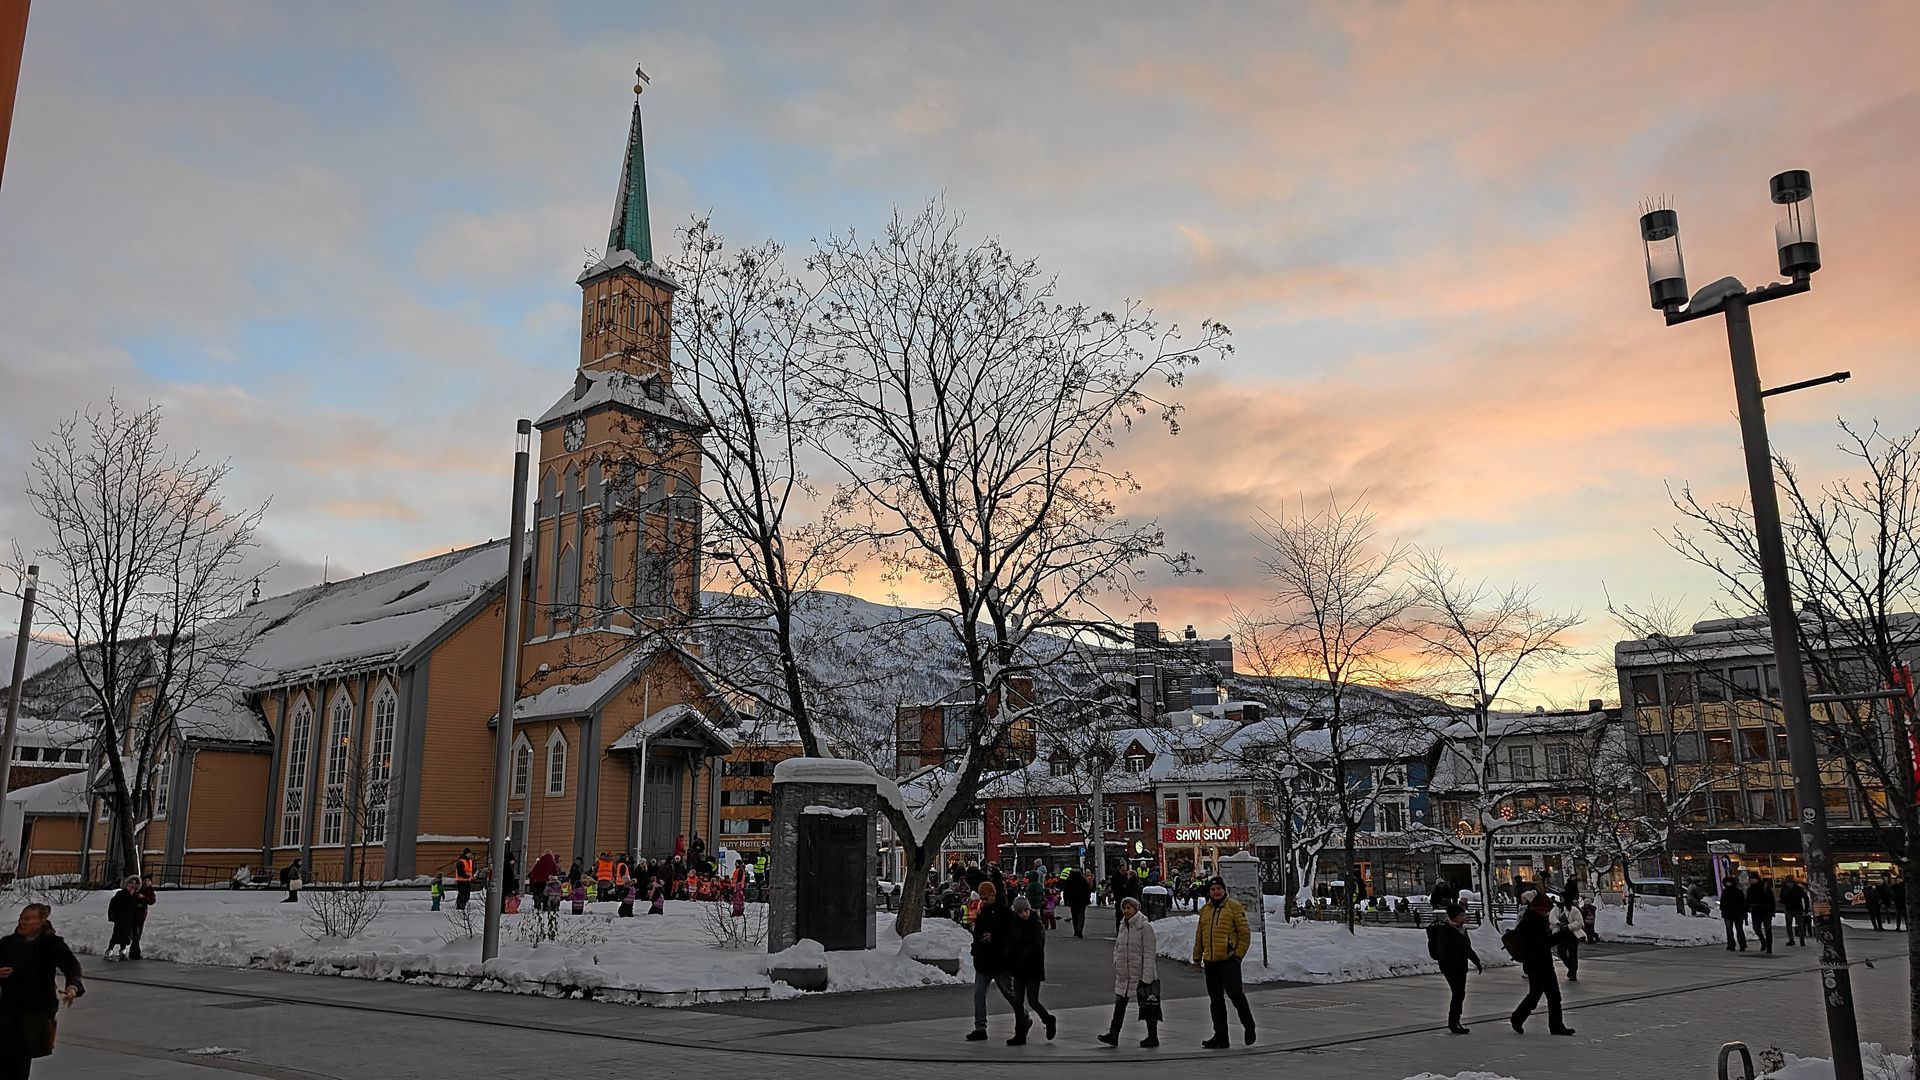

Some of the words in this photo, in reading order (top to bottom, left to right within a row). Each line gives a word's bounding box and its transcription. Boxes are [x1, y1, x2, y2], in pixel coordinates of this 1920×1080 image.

[1175, 829, 1201, 840] SAMI
[1203, 828, 1232, 840] SHOP
[739, 840, 760, 848] HOTEL
